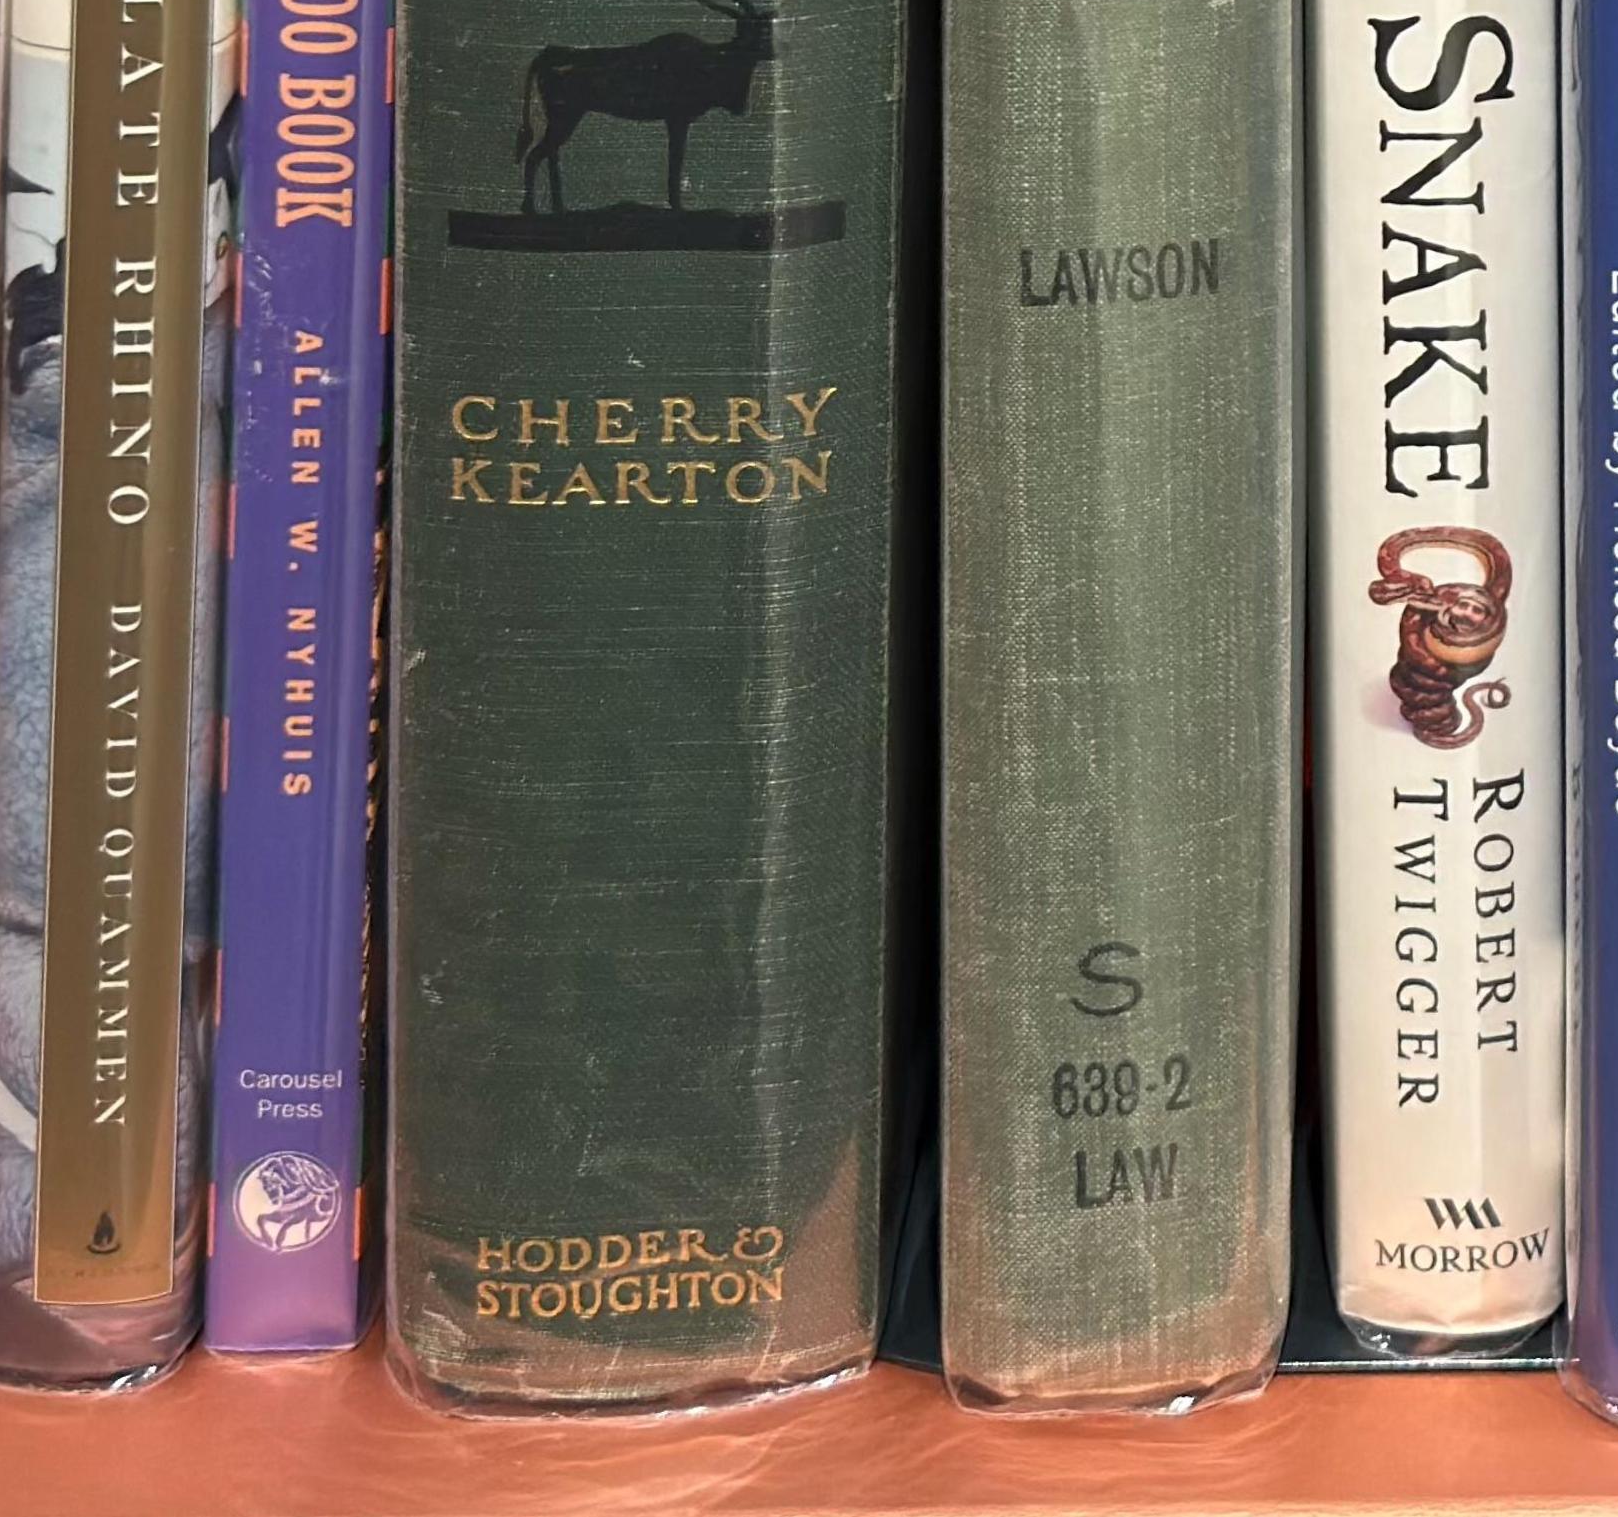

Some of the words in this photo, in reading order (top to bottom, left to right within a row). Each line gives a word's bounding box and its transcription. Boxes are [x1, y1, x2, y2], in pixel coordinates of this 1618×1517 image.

[275, 73, 357, 229] BOOK
[1020, 237, 1220, 308] LAWSON
[1367, 15, 1515, 498] SNAKE
[108, 257, 158, 525] RHINO
[291, 329, 323, 484] ALLEN
[450, 387, 837, 446] CHERRY
[449, 450, 833, 506] KEARTON
[287, 520, 320, 572] W.
[105, 603, 143, 799] DAVID
[282, 607, 316, 796] NYHUIS
[1393, 777, 1449, 1107] TWIGGER
[1472, 768, 1524, 1053] ROBERT
[93, 827, 135, 1126] QUAMMEN
[1071, 941, 1144, 1016] S
[240, 1069, 342, 1089] Carousel
[258, 1099, 323, 1118] Press
[1075, 1143, 1178, 1208] LAW
[477, 1228, 729, 1274] HODDER
[733, 1226, 784, 1263] &
[1375, 1227, 1550, 1273] MORROW
[477, 1267, 785, 1320] STOUGHTON
